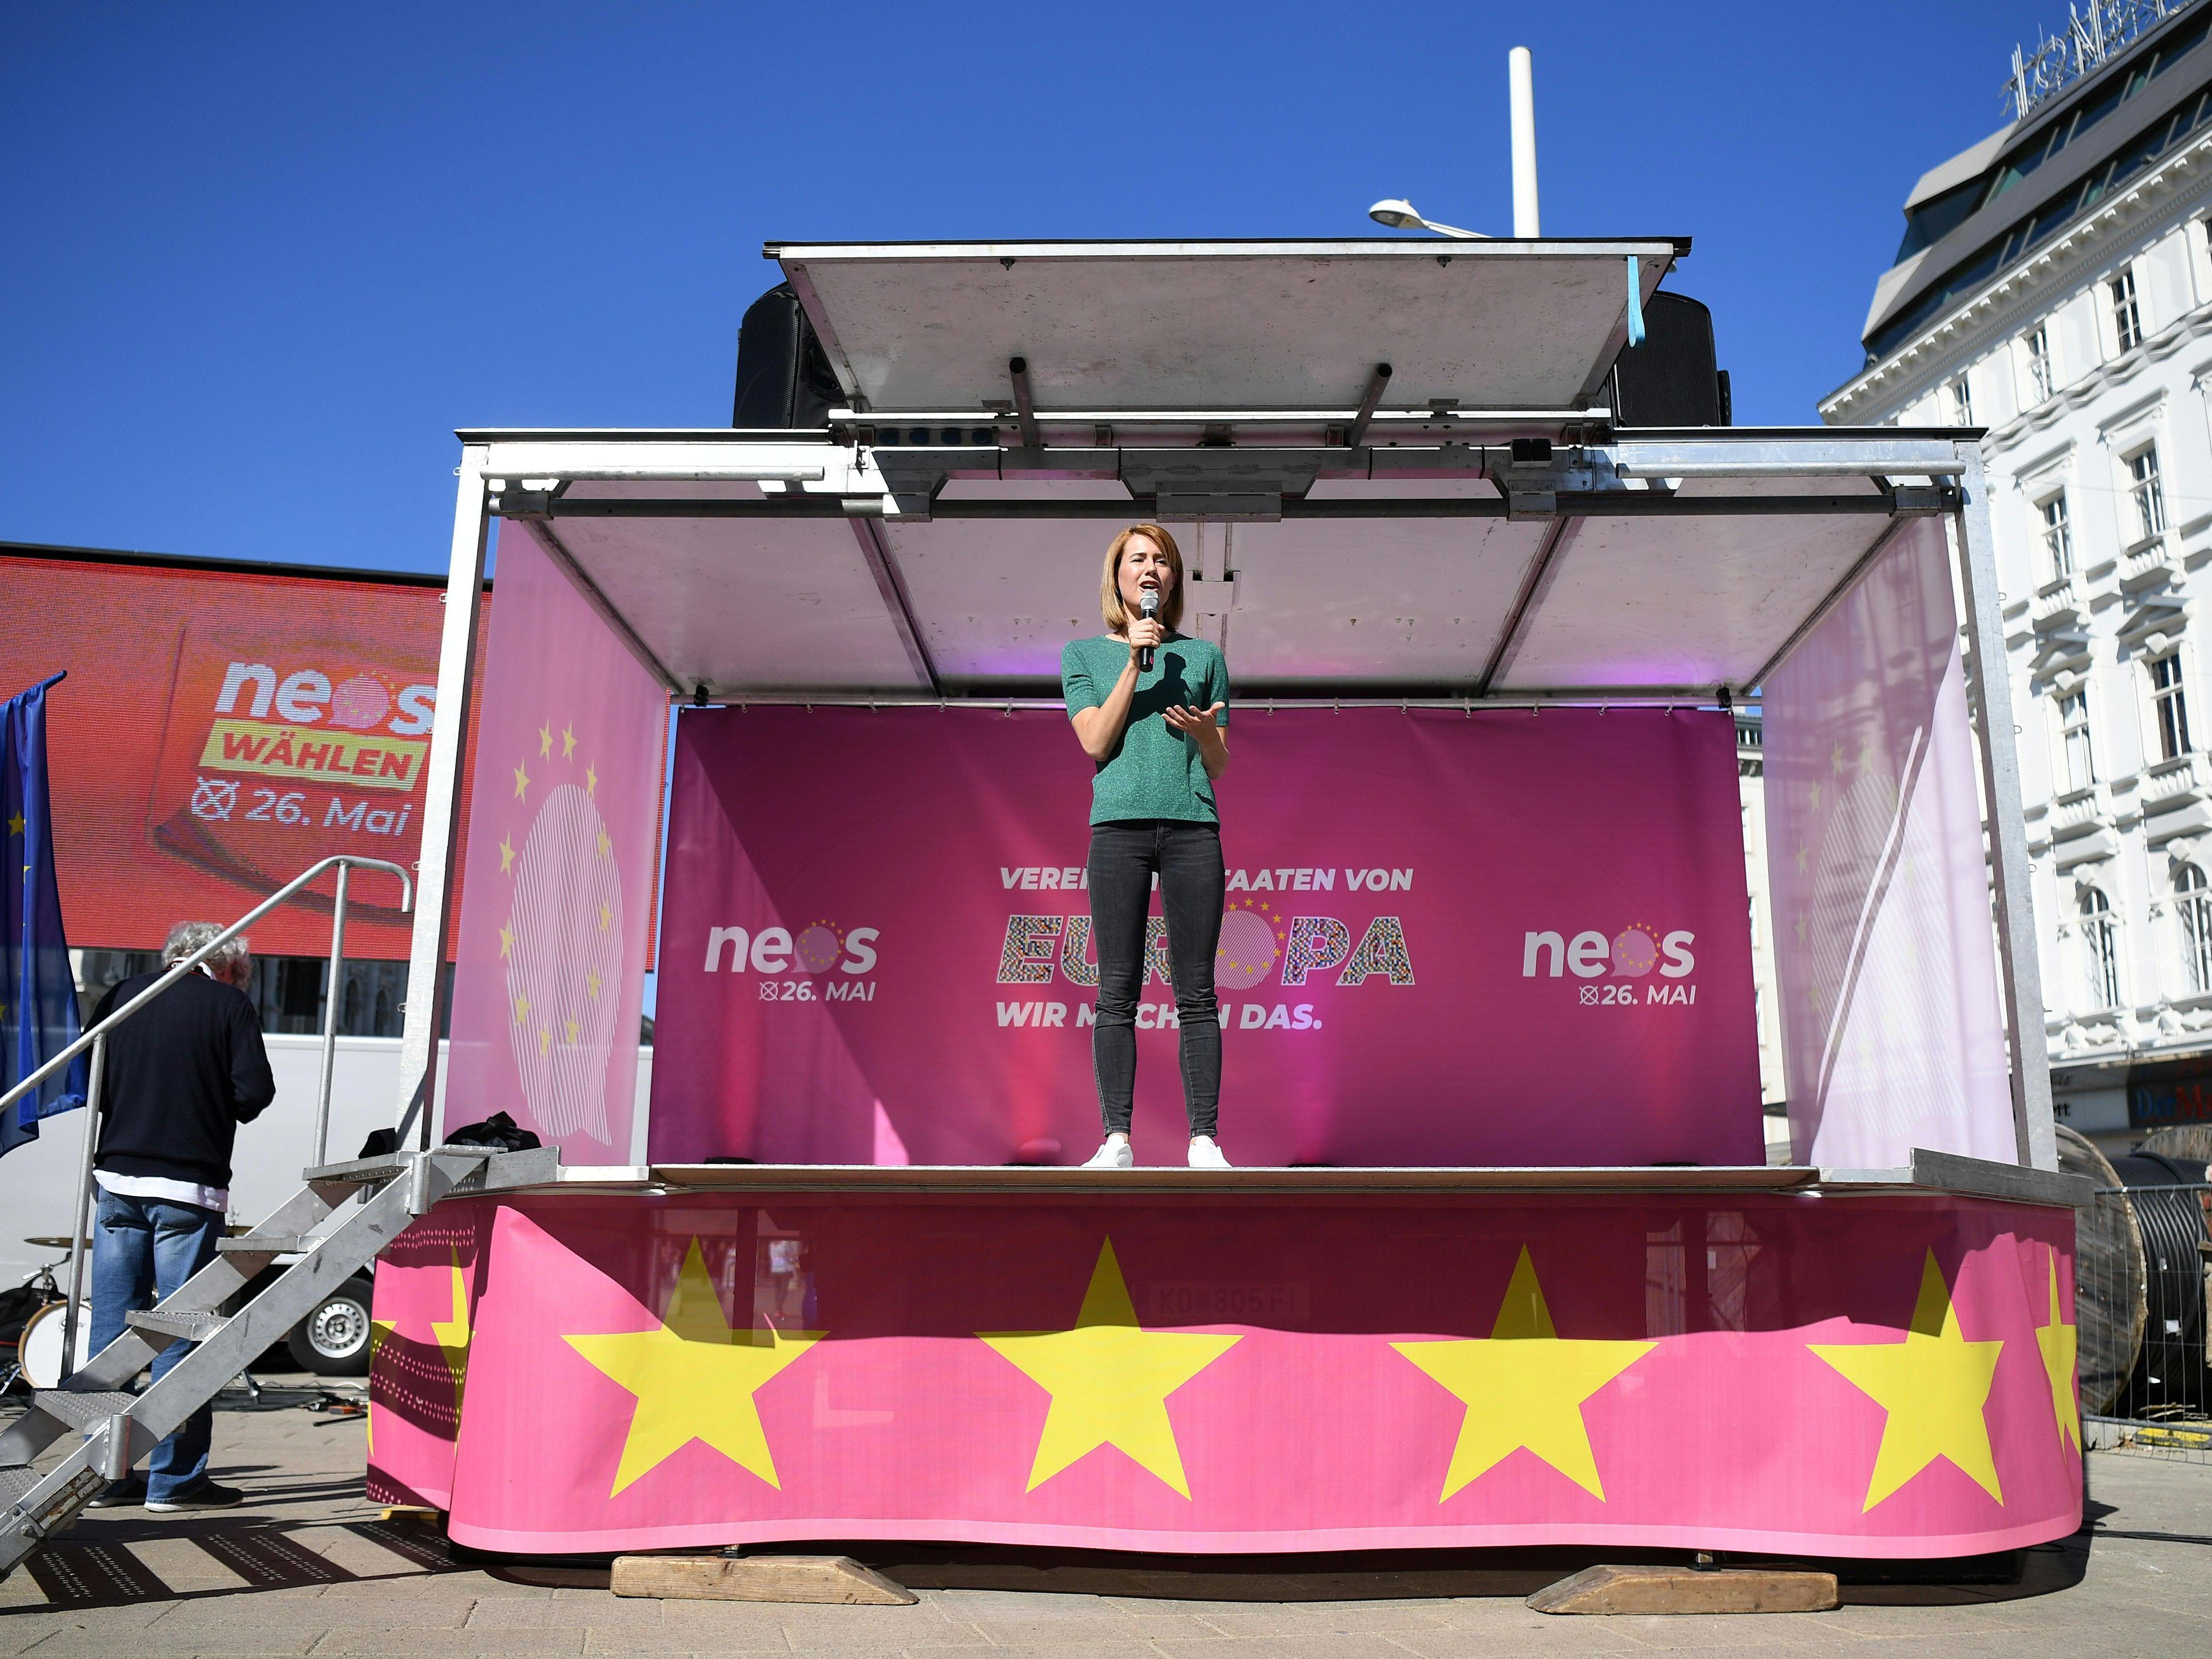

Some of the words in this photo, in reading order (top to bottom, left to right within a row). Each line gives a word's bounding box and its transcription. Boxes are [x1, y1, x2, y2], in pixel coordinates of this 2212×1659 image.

[214, 661, 437, 735] neos
[223, 731, 414, 780] WÄHLEN
[244, 789, 311, 825] 26.
[323, 798, 413, 836] Mai
[1345, 868, 1414, 892] VON
[704, 926, 880, 975] neos
[1523, 930, 1695, 978] neos
[780, 981, 817, 1001] 26.
[825, 981, 876, 1001] MAI
[1602, 984, 1638, 1005] 26.
[1647, 984, 1696, 1005] MAI
[996, 1001, 1068, 1028] WIR
[1239, 1003, 1323, 1030] DAS.
